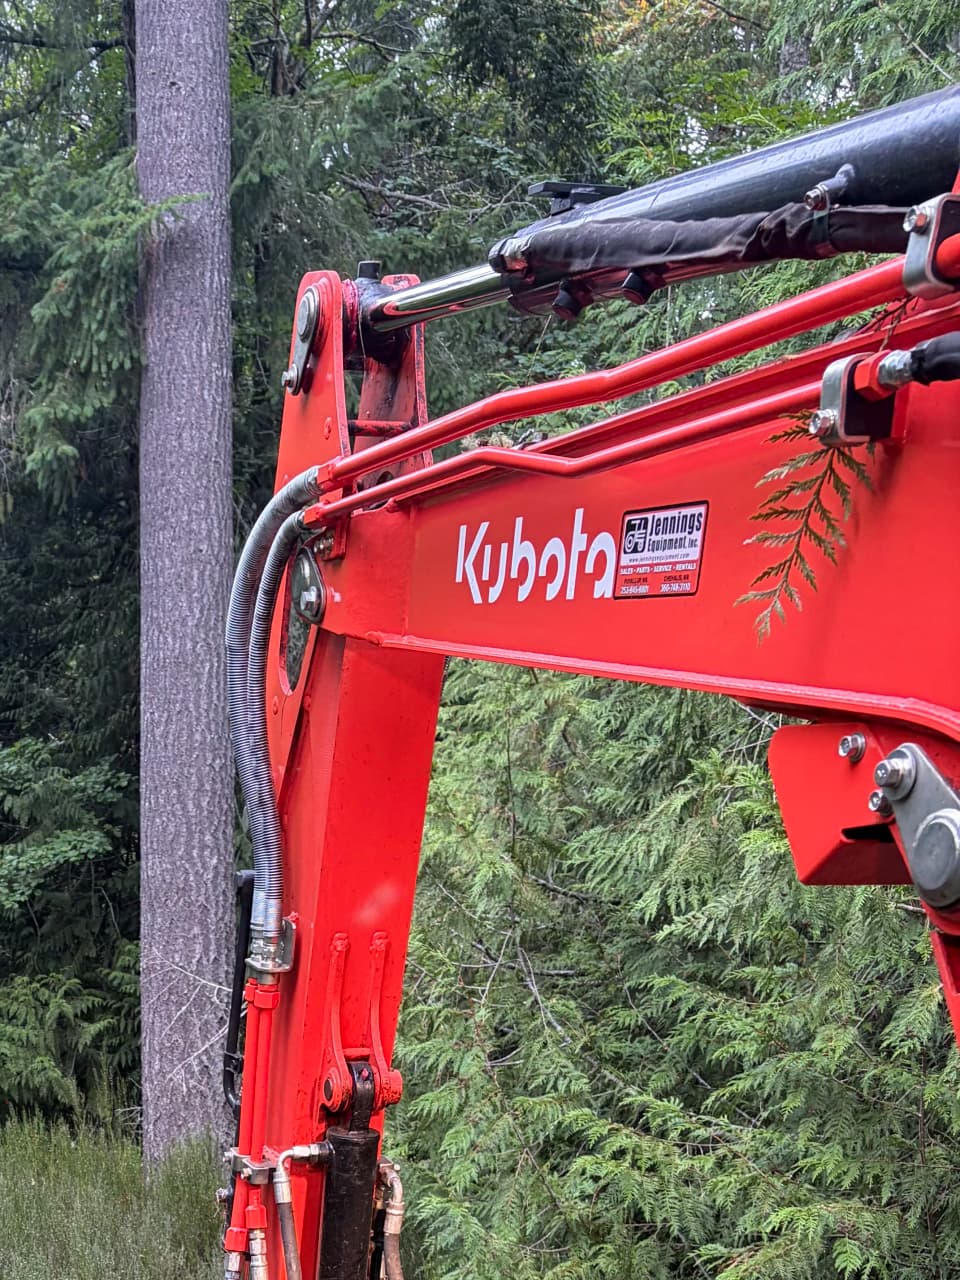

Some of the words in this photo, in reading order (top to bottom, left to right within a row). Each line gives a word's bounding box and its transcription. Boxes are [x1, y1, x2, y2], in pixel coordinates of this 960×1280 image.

[649, 511, 703, 536] Jennings
[688, 537, 699, 549] Inc.
[456, 508, 617, 604] Kubota
[620, 567, 633, 575] SALES
[636, 566, 650, 574] PARTS
[653, 564, 672, 573] SERVICE
[675, 563, 696, 571] RENTALS
